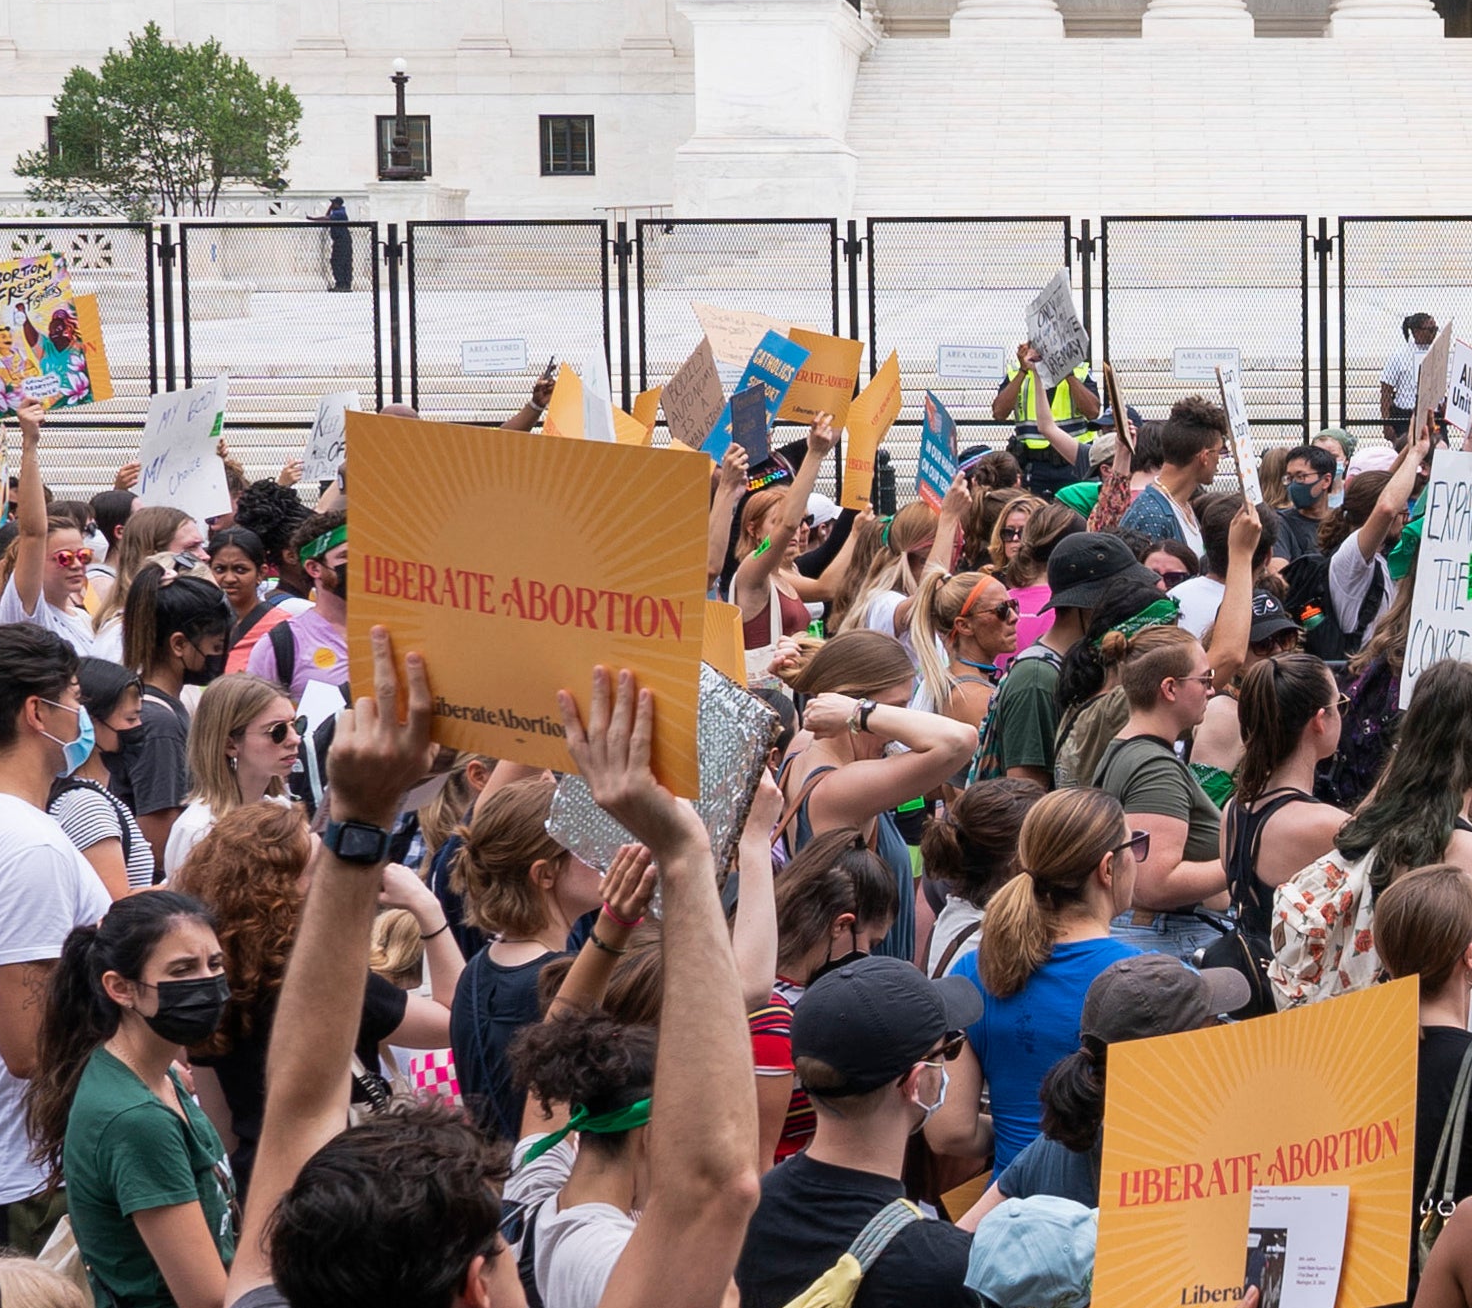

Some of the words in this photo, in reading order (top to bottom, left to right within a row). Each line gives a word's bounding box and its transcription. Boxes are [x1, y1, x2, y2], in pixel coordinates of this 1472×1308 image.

[753, 349, 795, 382] CATHOLICS
[795, 370, 825, 386] ERATE
[364, 554, 496, 615] LIBERATE
[502, 576, 684, 643] ABORTION
[1434, 558, 1469, 614] THE
[1119, 1153, 1263, 1208] LIBERATE
[1267, 1117, 1400, 1186] ABORTION
